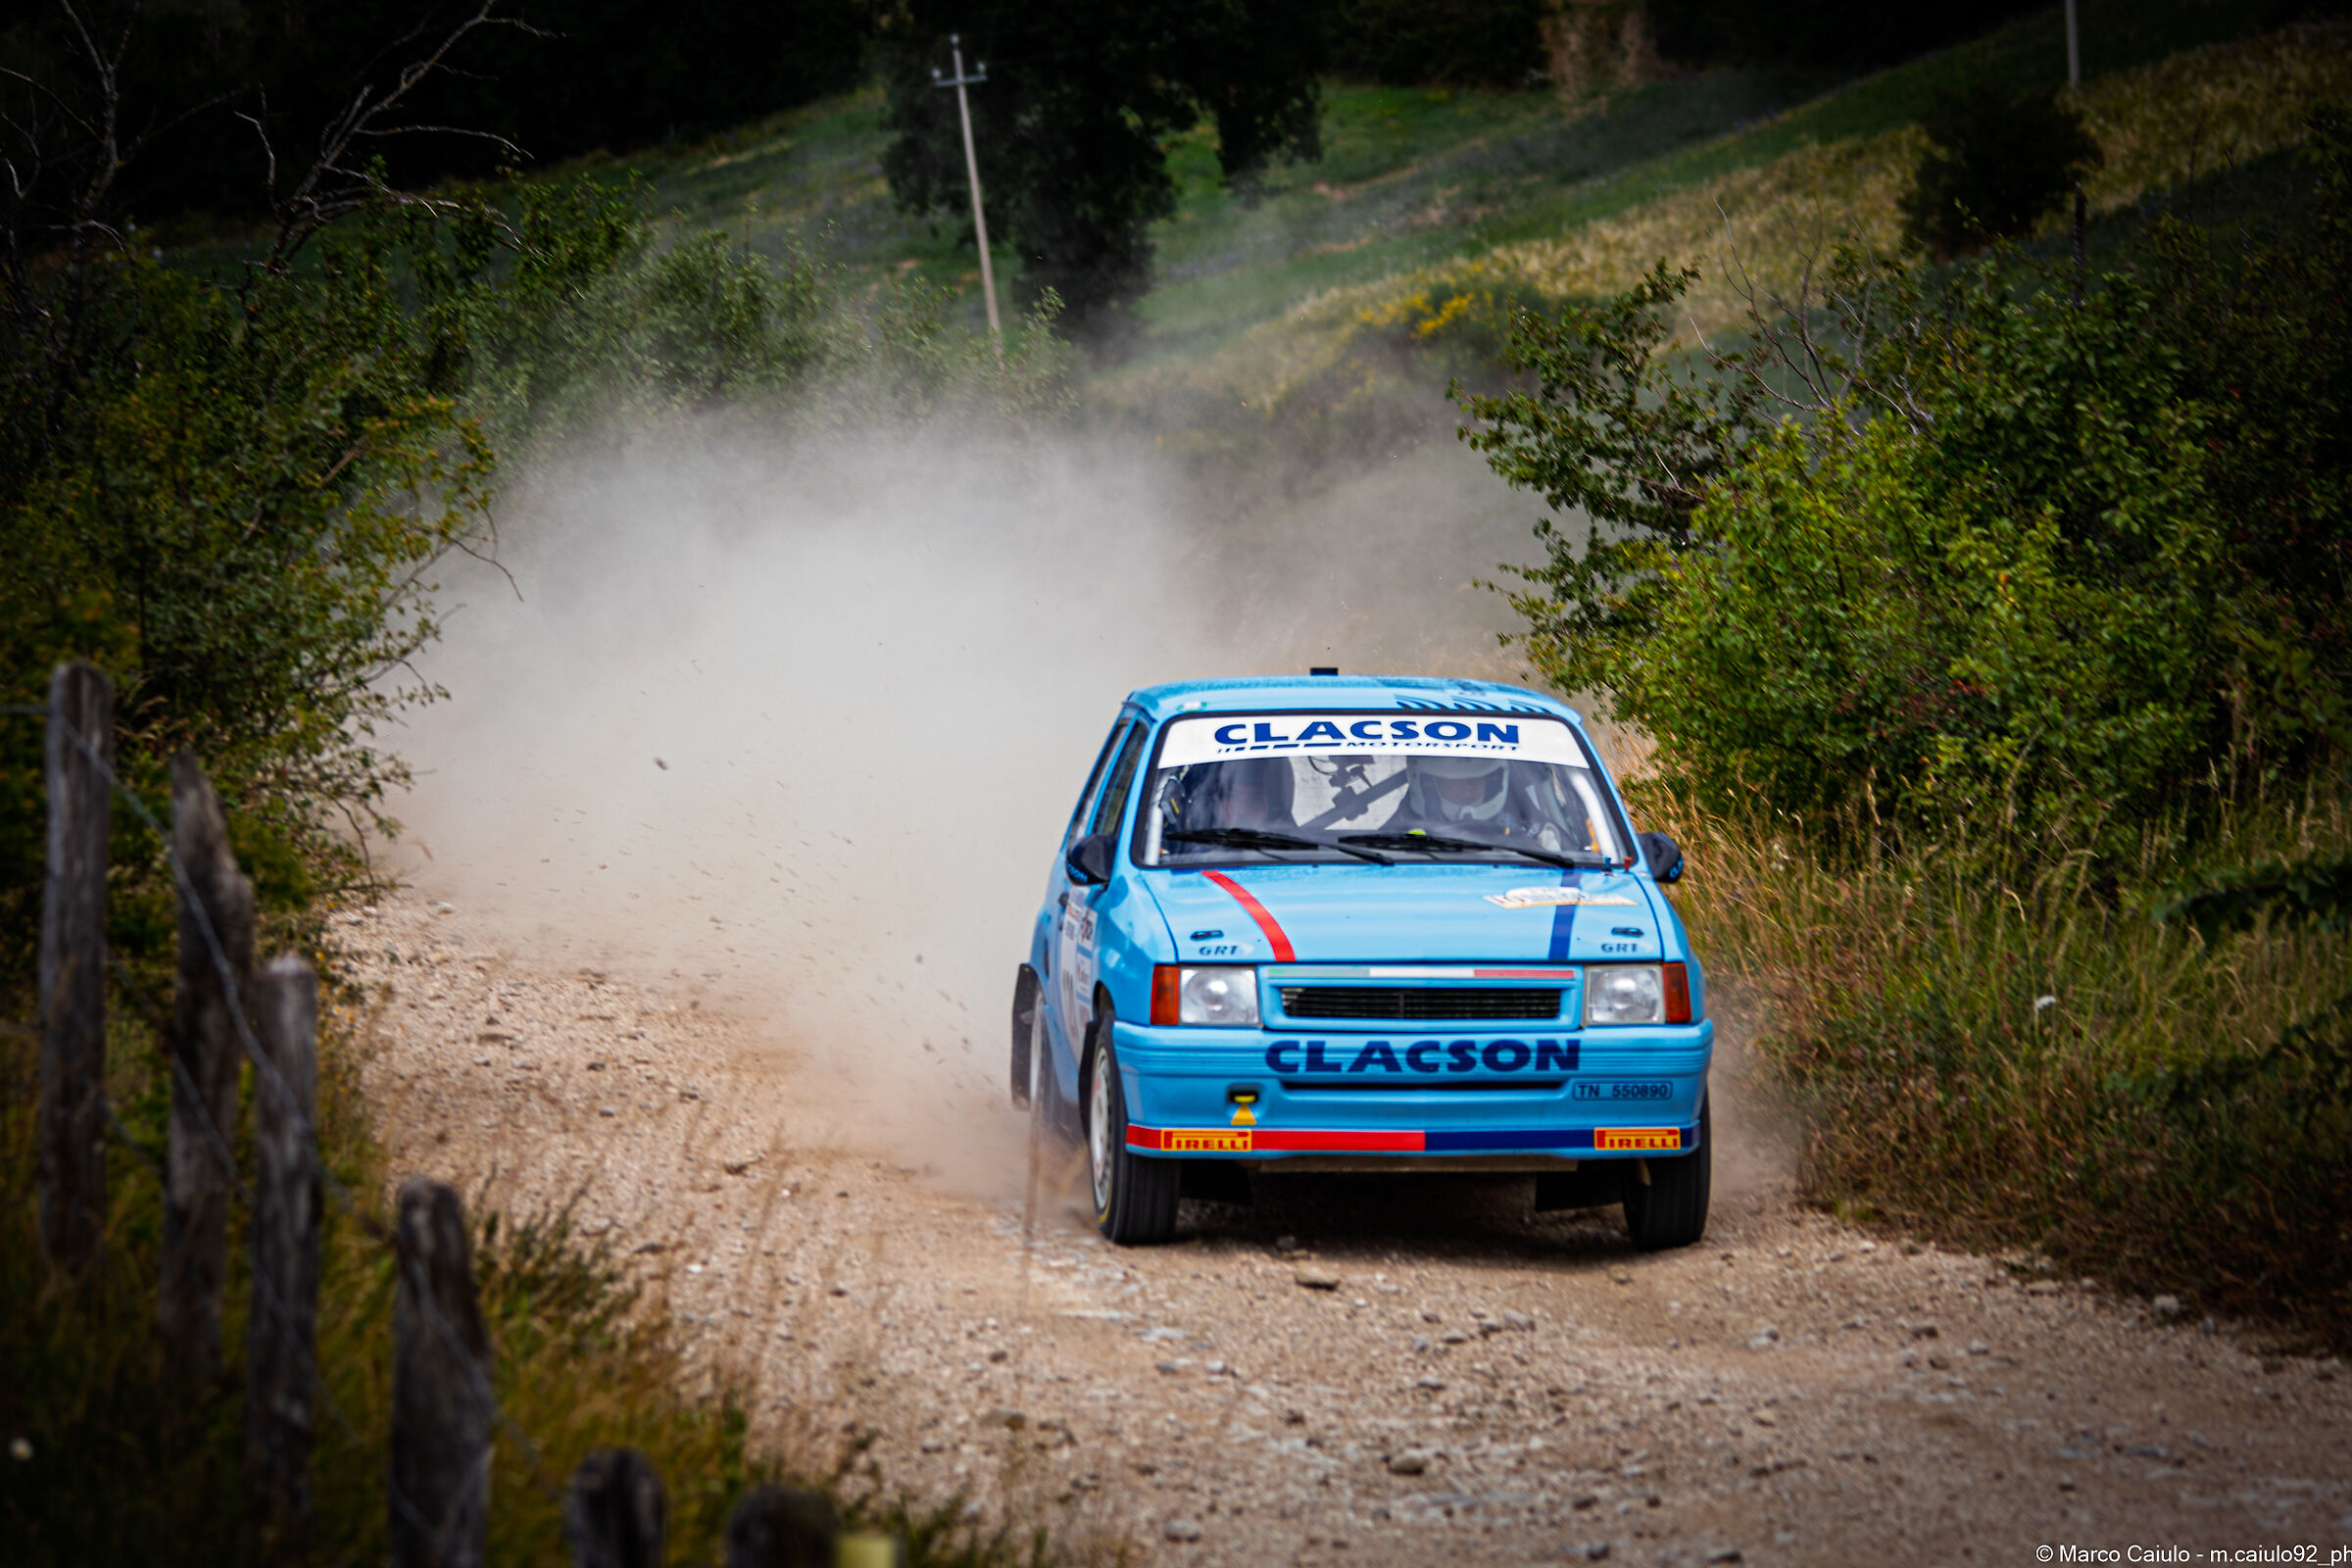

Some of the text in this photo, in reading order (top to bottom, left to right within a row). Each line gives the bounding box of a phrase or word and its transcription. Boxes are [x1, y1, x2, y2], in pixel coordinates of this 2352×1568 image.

[1214, 720, 1519, 745] CLACSON
[1347, 741, 1519, 752] MOTORSPORT
[1264, 1039, 1581, 1073] CLACSON
[1578, 1084, 1668, 1099] TN 550890
[1163, 1130, 1250, 1150] PIRELLI
[1594, 1128, 1679, 1150] PIRELLI
